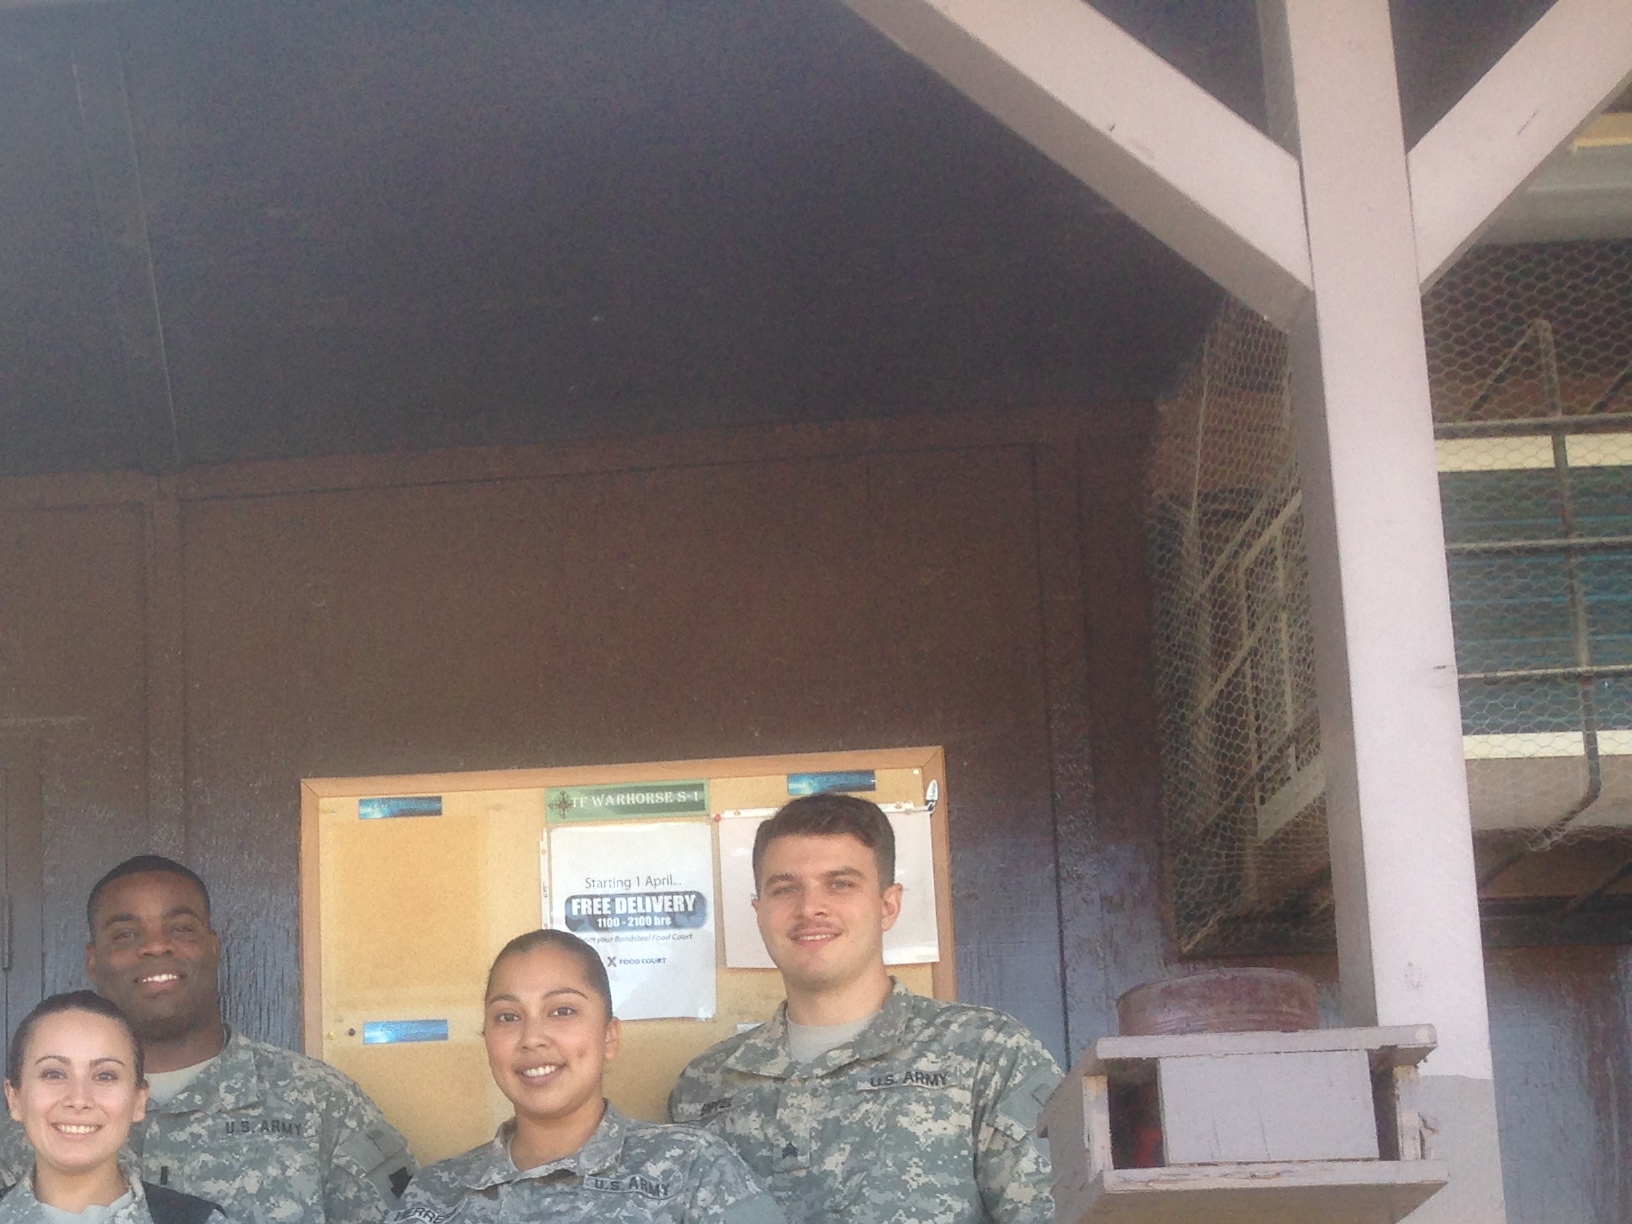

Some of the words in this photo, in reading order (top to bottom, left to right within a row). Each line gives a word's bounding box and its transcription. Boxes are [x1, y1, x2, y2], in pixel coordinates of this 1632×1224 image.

[570, 796, 588, 808] TF
[591, 791, 673, 807] WARHORSE
[676, 790, 699, 803] S-1
[585, 876, 632, 891] Starting
[636, 876, 641, 887] 1
[571, 896, 612, 916] FREE
[614, 894, 696, 915] DELIVERY
[596, 917, 621, 928] 1100
[626, 915, 653, 927] 2100
[653, 915, 672, 926] hrs
[652, 932, 671, 941] Food
[671, 932, 693, 941] Court
[619, 956, 641, 965] FOOD
[642, 957, 667, 965] COURT
[902, 1071, 948, 1087] ARMY
[260, 1120, 302, 1136] ARMY
[628, 1176, 670, 1197] ARMY
